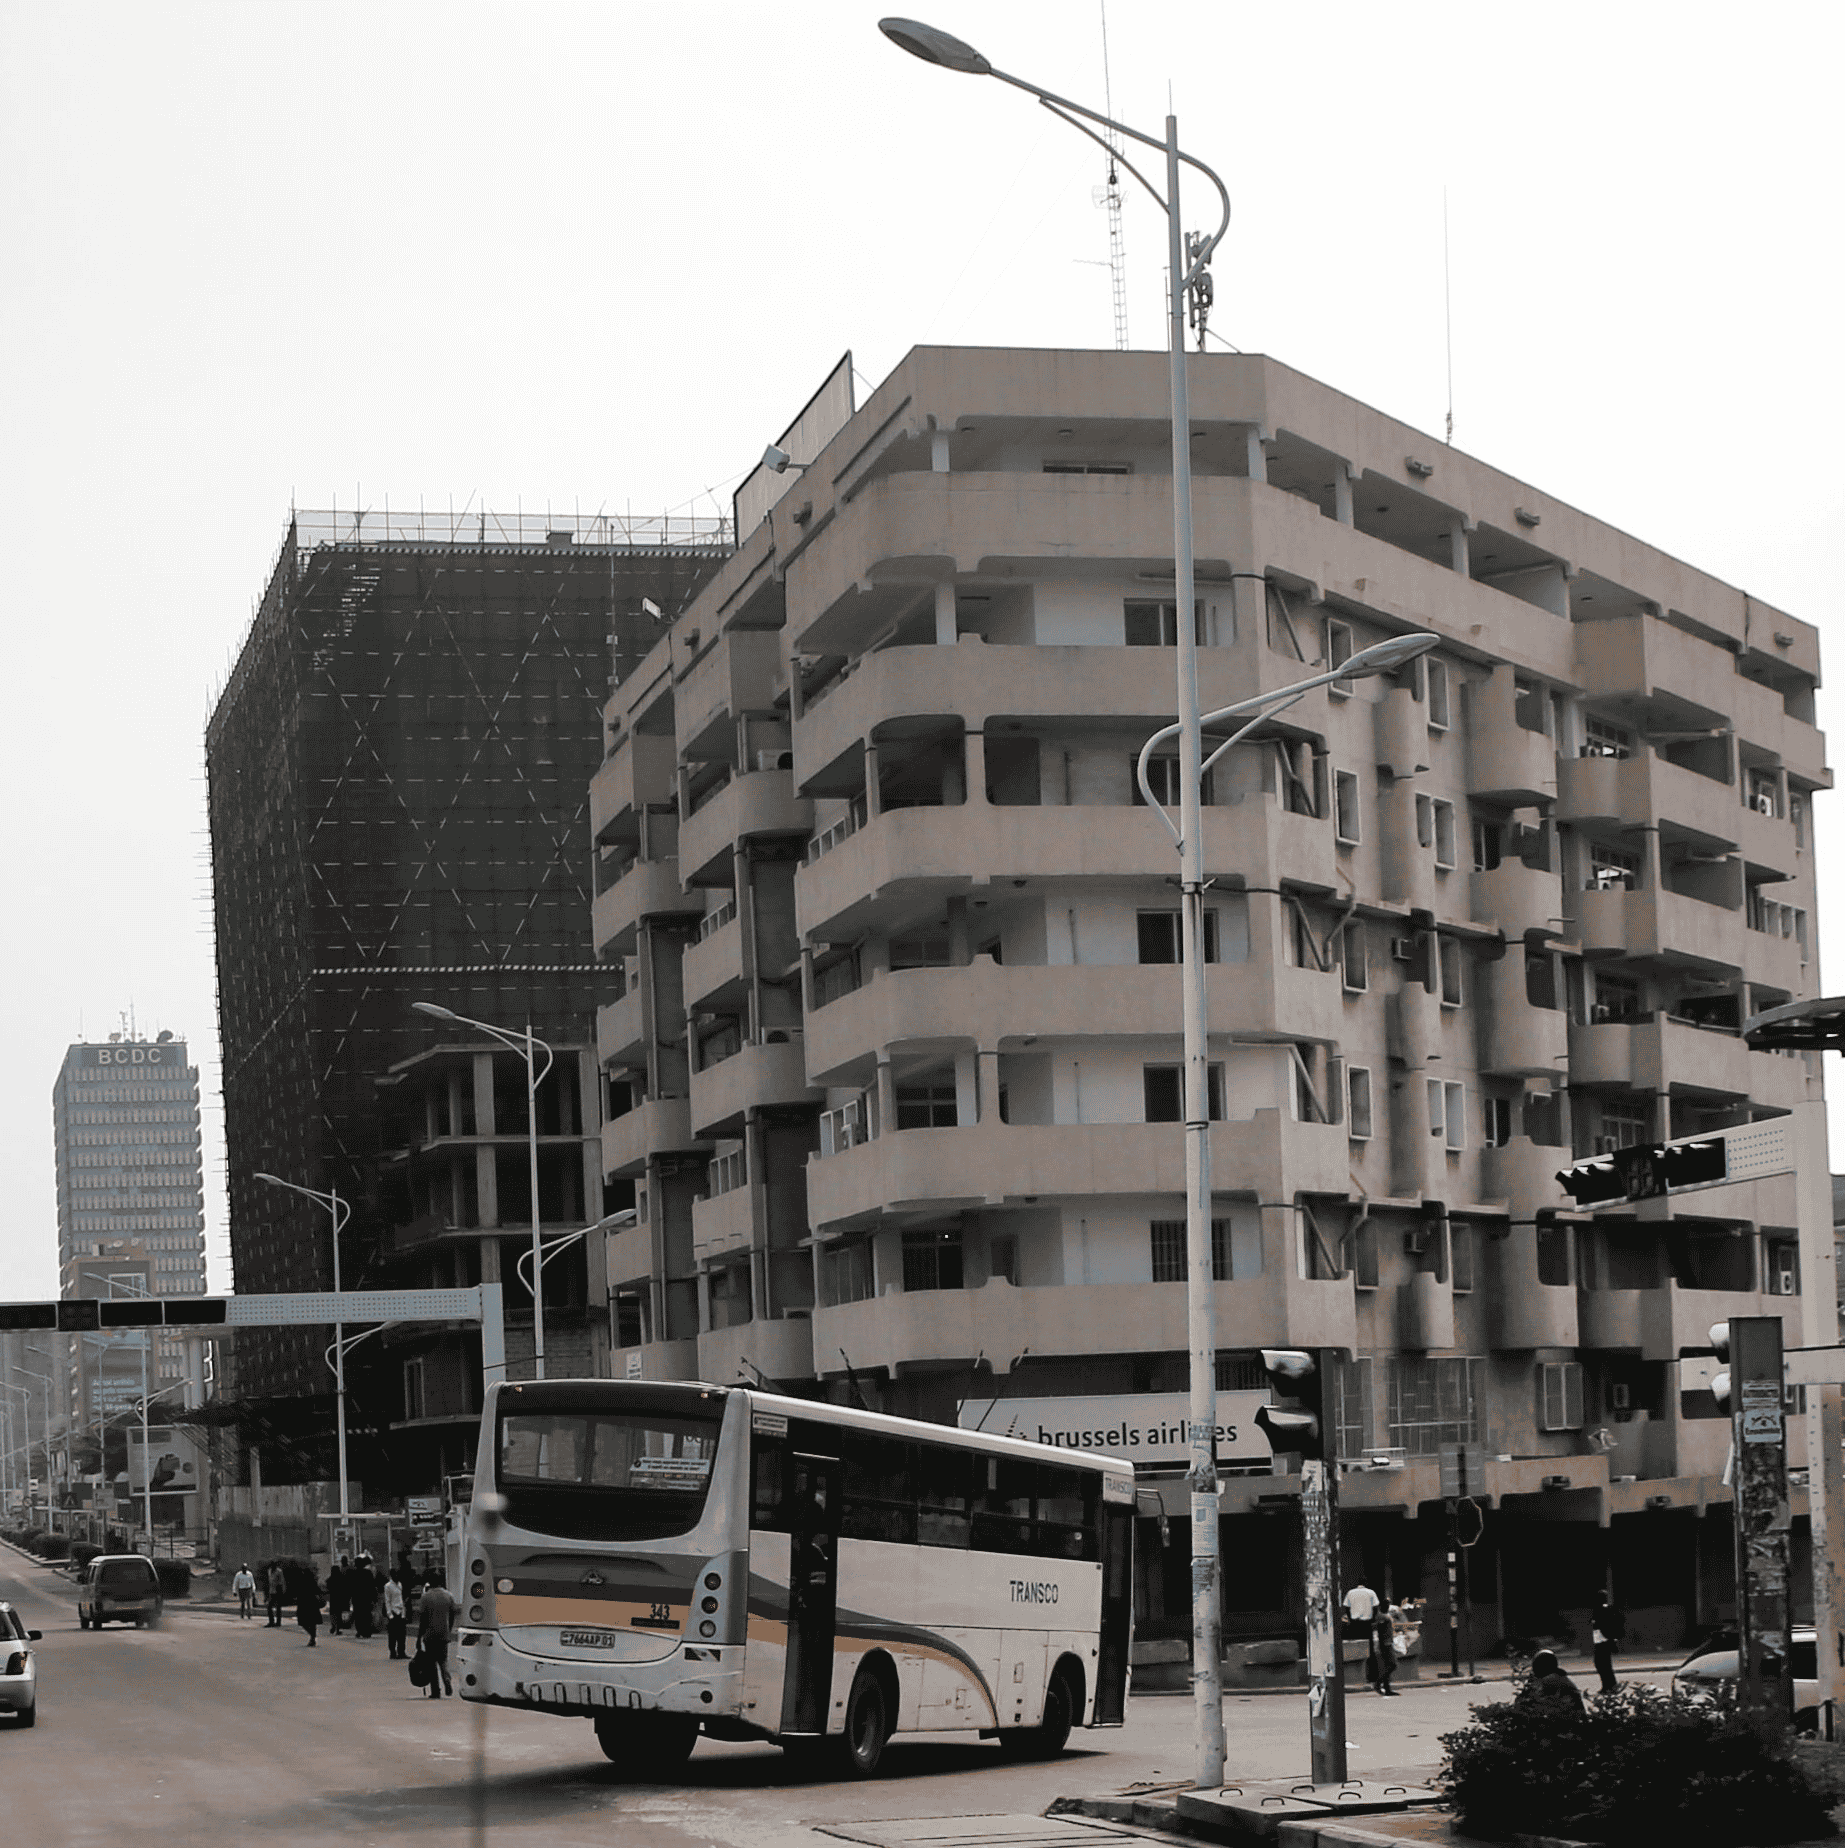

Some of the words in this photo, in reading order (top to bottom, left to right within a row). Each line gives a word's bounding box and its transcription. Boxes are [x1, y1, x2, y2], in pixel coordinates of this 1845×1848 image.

[98, 1048, 161, 1064] BCDC
[1038, 1422, 1140, 1448] brussels
[1009, 1580, 1059, 1604] TRANSCO
[649, 1603, 670, 1620] 343
